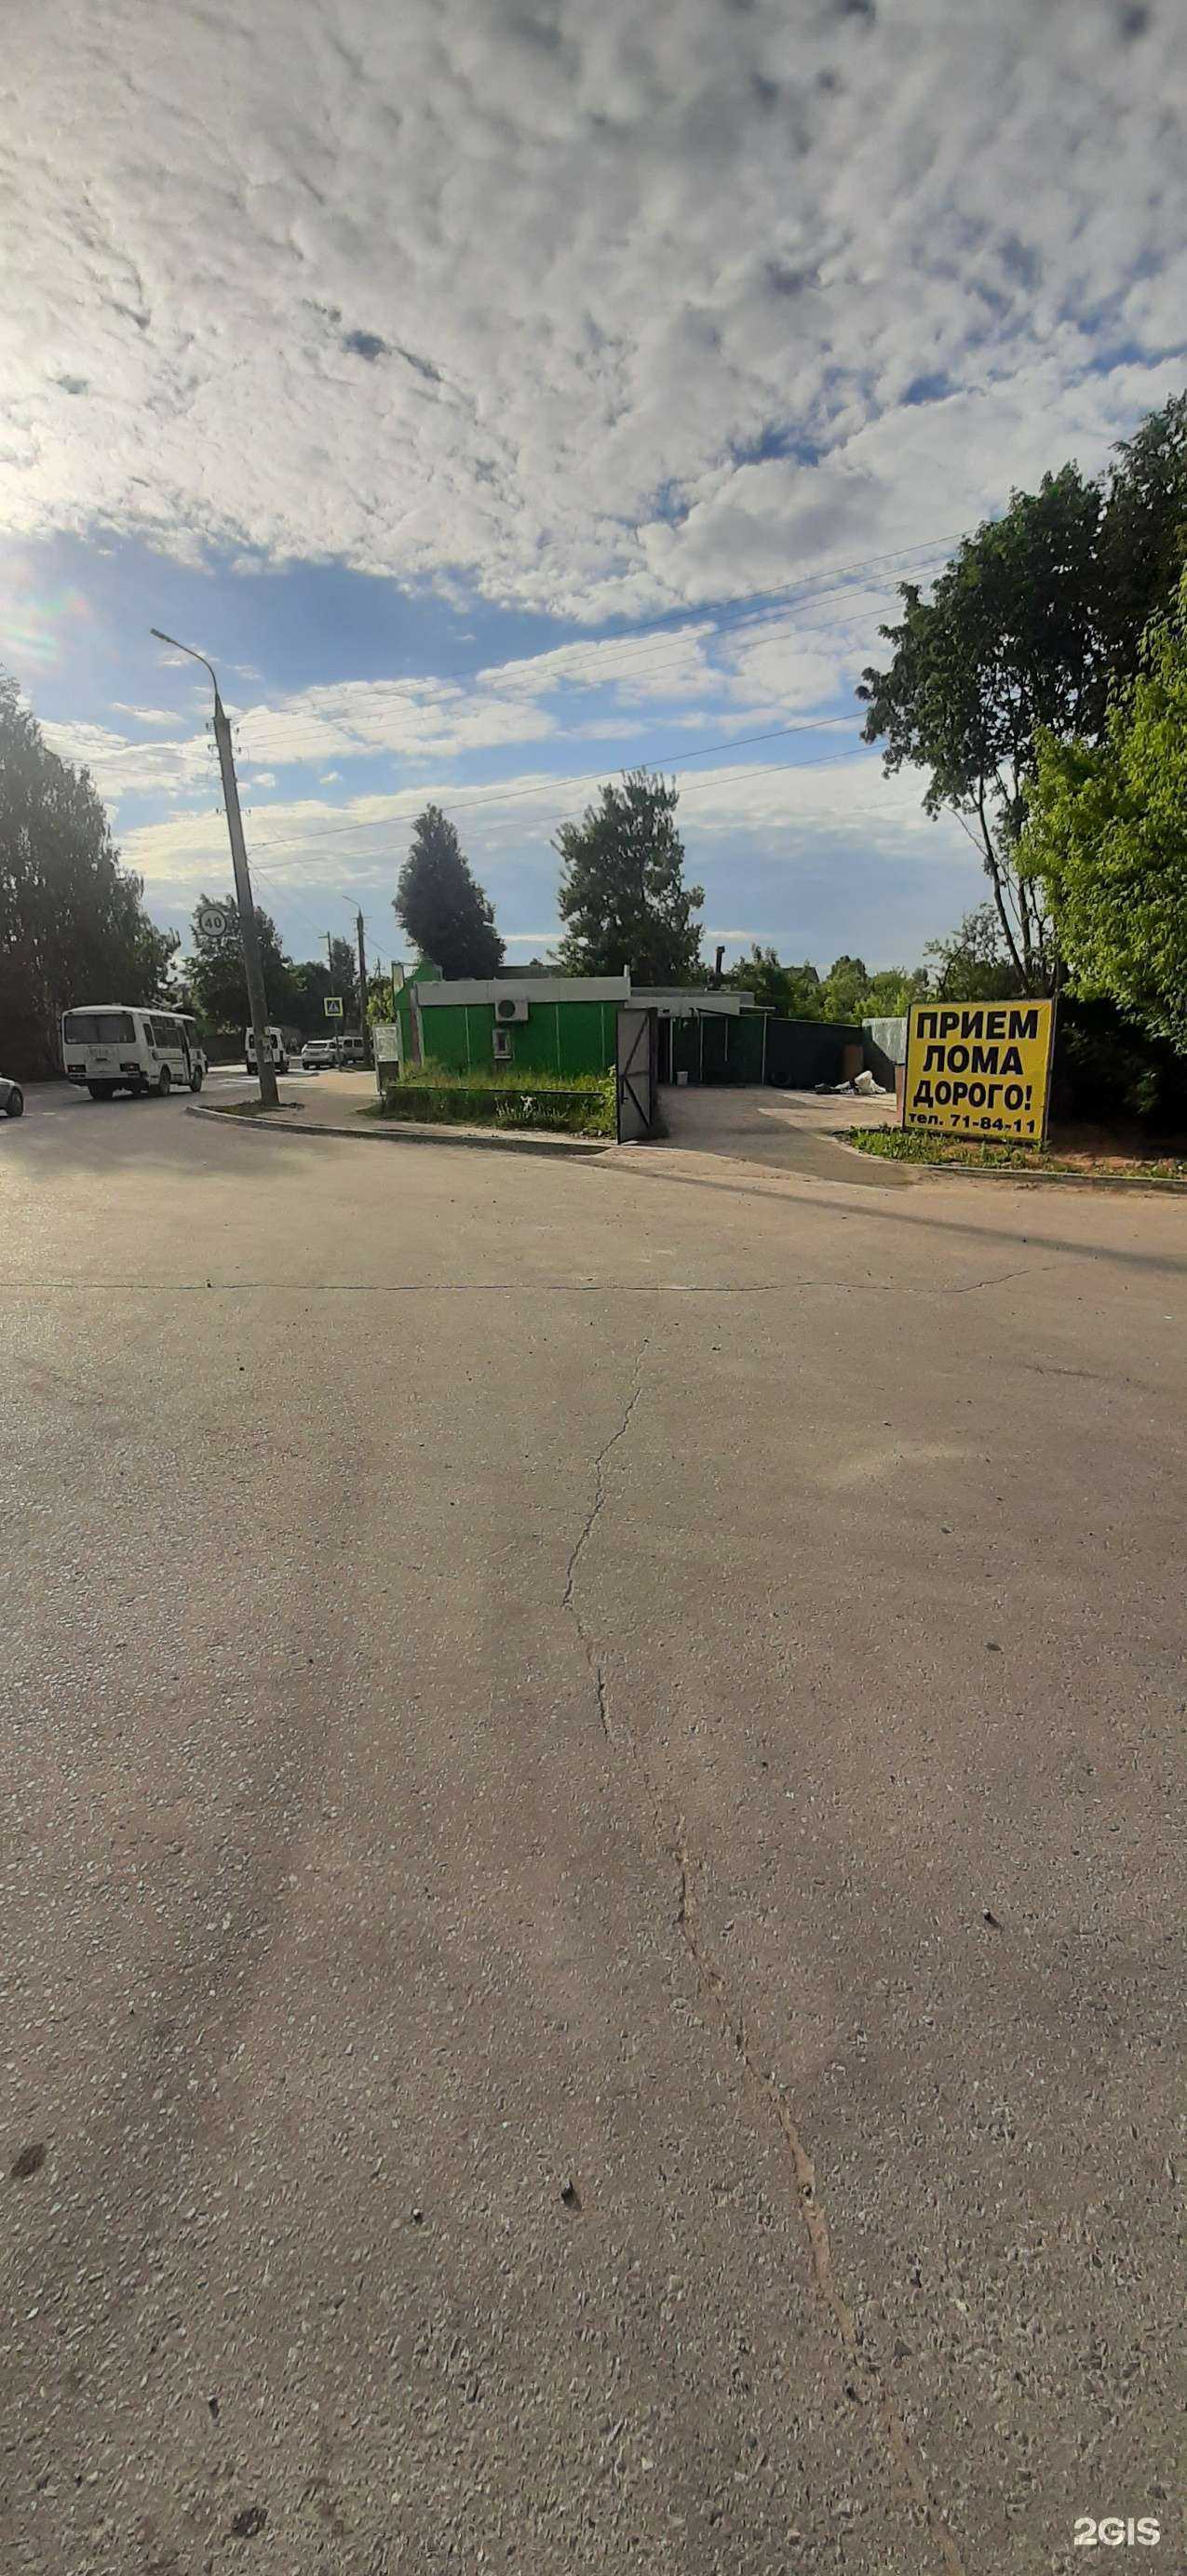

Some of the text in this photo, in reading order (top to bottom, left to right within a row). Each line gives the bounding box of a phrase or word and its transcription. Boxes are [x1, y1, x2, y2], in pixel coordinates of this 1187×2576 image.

[205, 917, 222, 929] 40
[917, 1011, 1039, 1040] ПРИЕМ
[923, 1045, 1023, 1075] ЛОМА
[913, 1080, 1032, 1110] ДОРОГО!
[909, 1113, 1035, 1133] тел. 71-84-11
